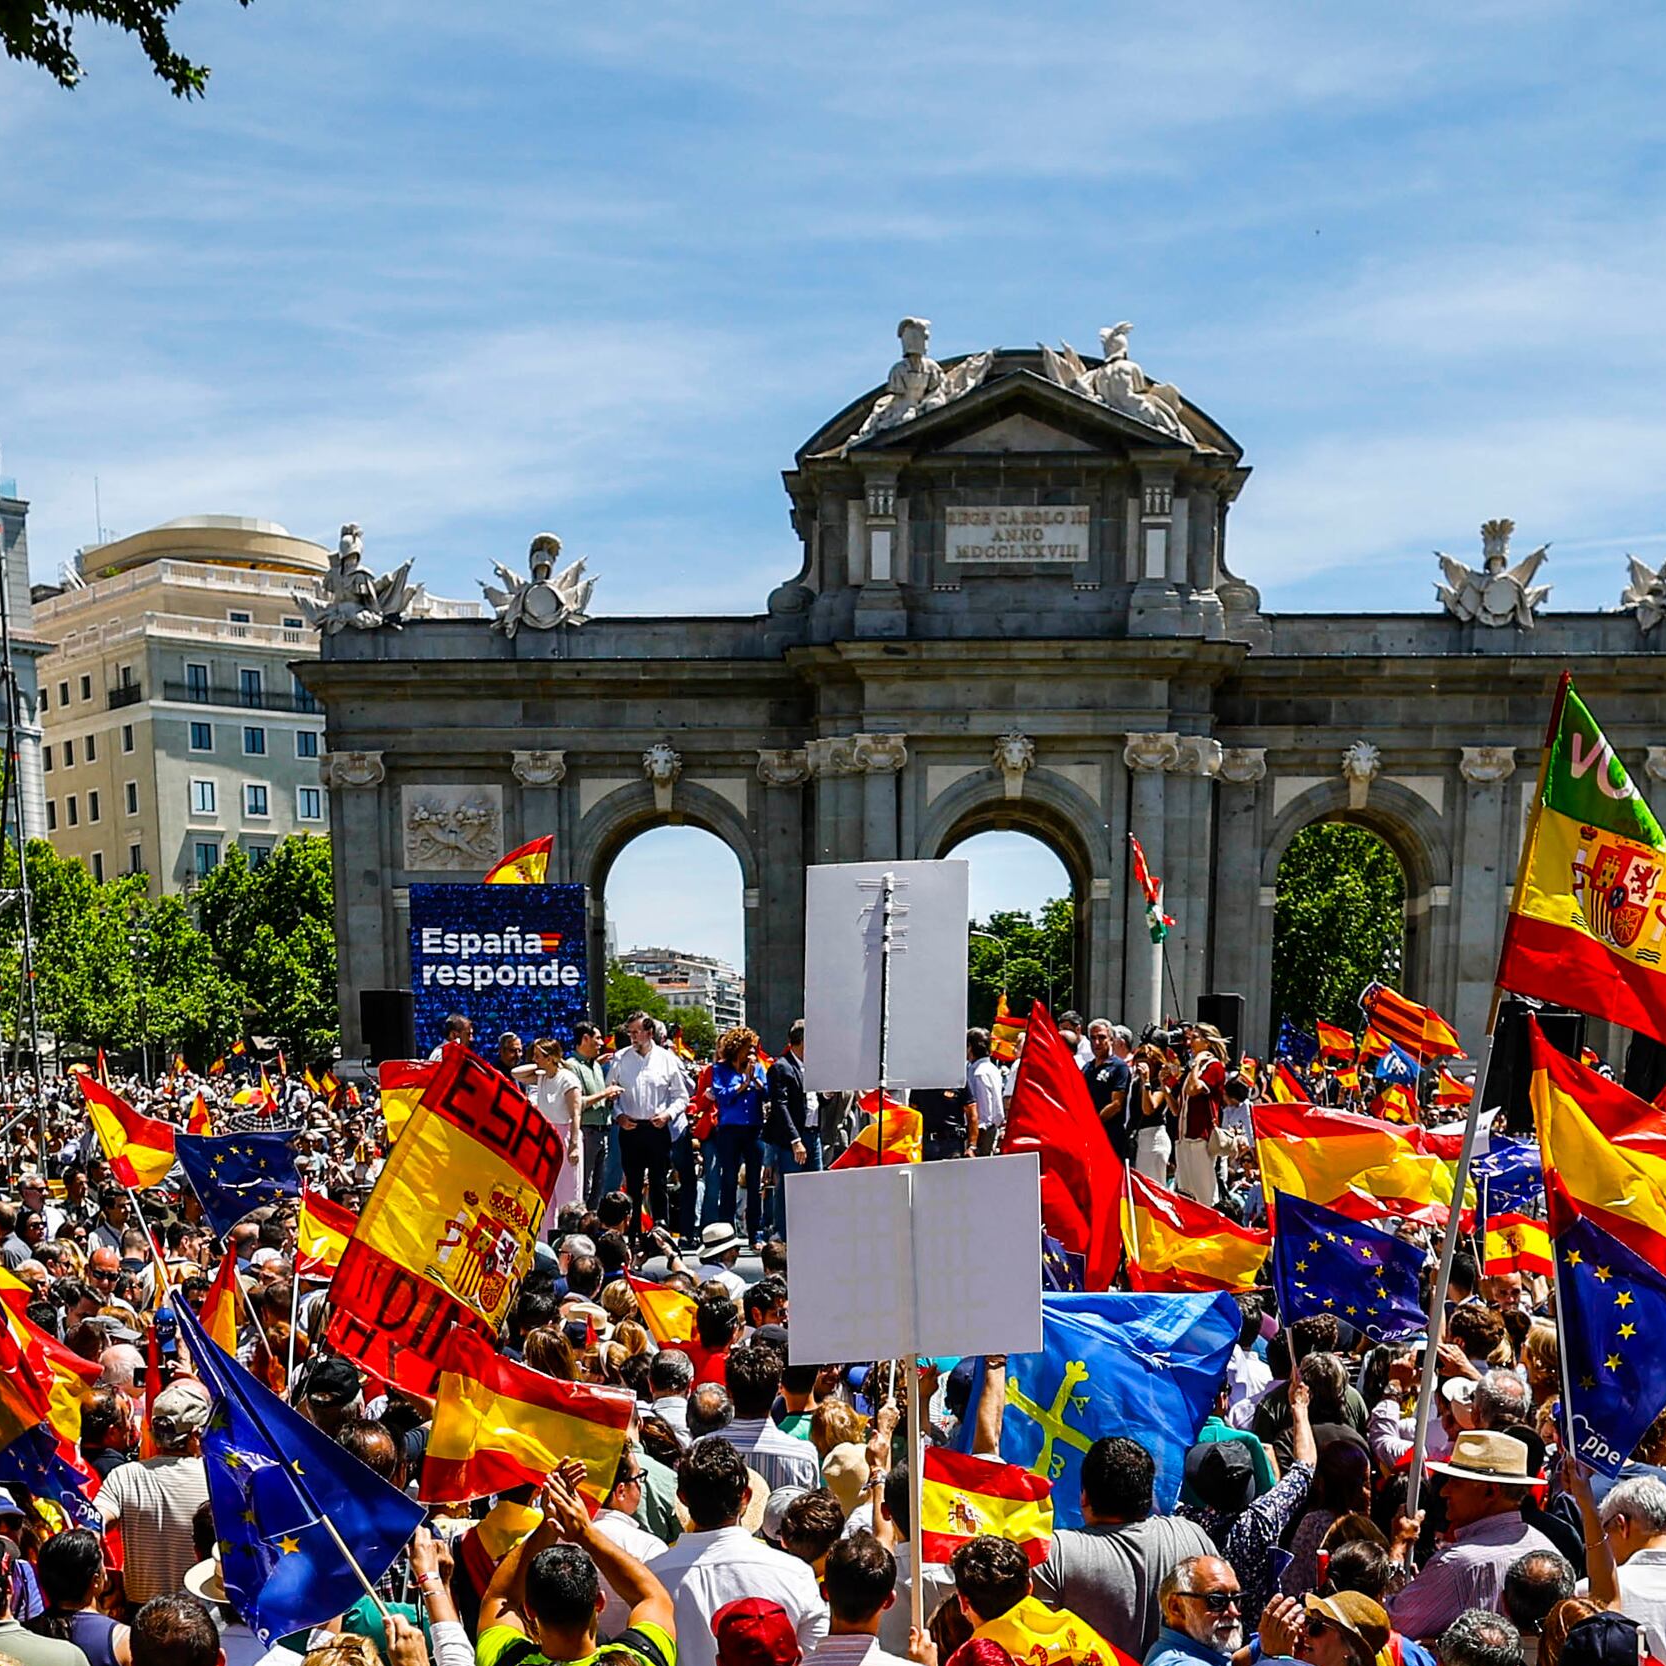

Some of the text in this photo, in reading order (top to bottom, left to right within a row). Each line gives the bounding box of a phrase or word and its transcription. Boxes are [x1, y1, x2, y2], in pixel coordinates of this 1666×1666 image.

[946, 511, 1089, 525] REGE CAROLO III
[991, 528, 1044, 541] ANNO
[955, 544, 1080, 558] MDCCLXXVIII
[1572, 732, 1641, 801] VO
[422, 926, 543, 960] España
[422, 959, 580, 991] responde
[1581, 1436, 1621, 1465] ppe
[76, 1504, 101, 1523] ppe
